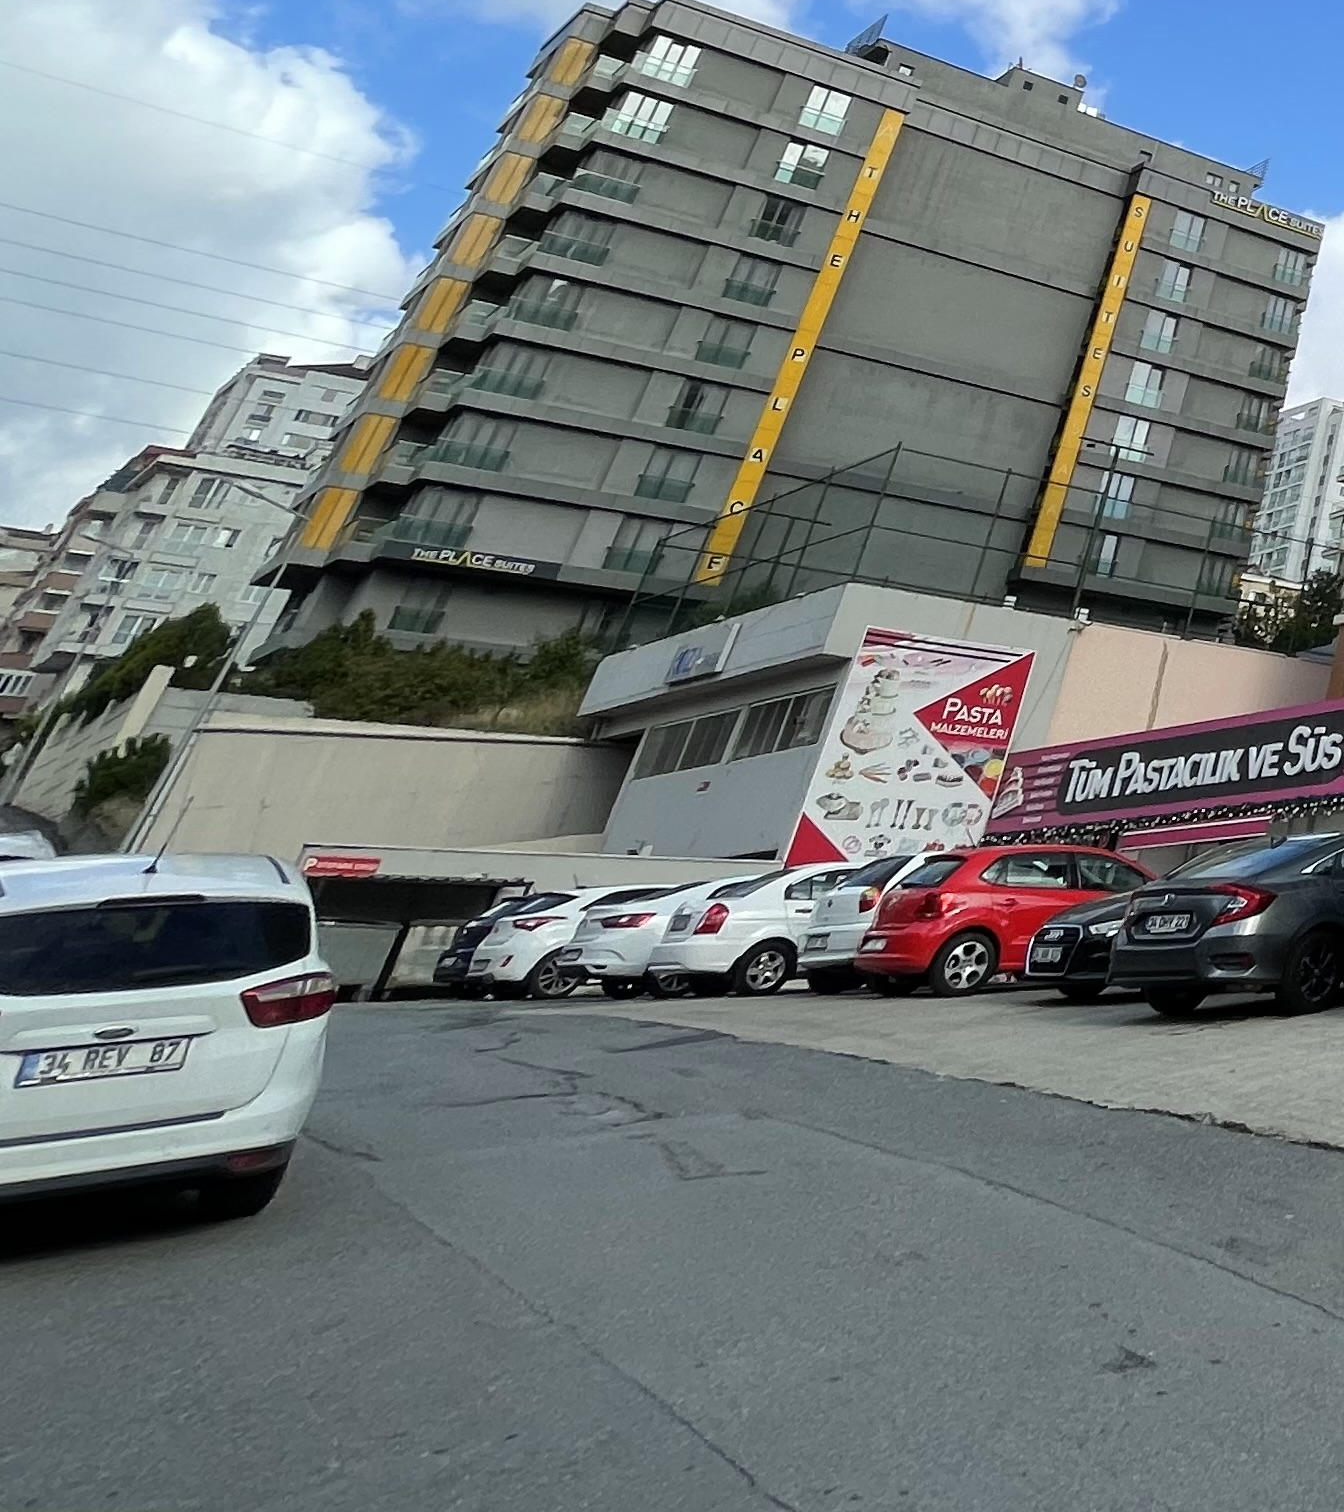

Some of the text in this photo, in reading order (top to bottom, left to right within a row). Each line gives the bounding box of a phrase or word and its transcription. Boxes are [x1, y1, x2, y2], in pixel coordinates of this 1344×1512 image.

[1213, 191, 1238, 205] THE
[1238, 196, 1289, 224] PLACE
[412, 548, 439, 560] THE
[1247, 742, 1285, 781] VE
[40, 1053, 70, 1075] 34
